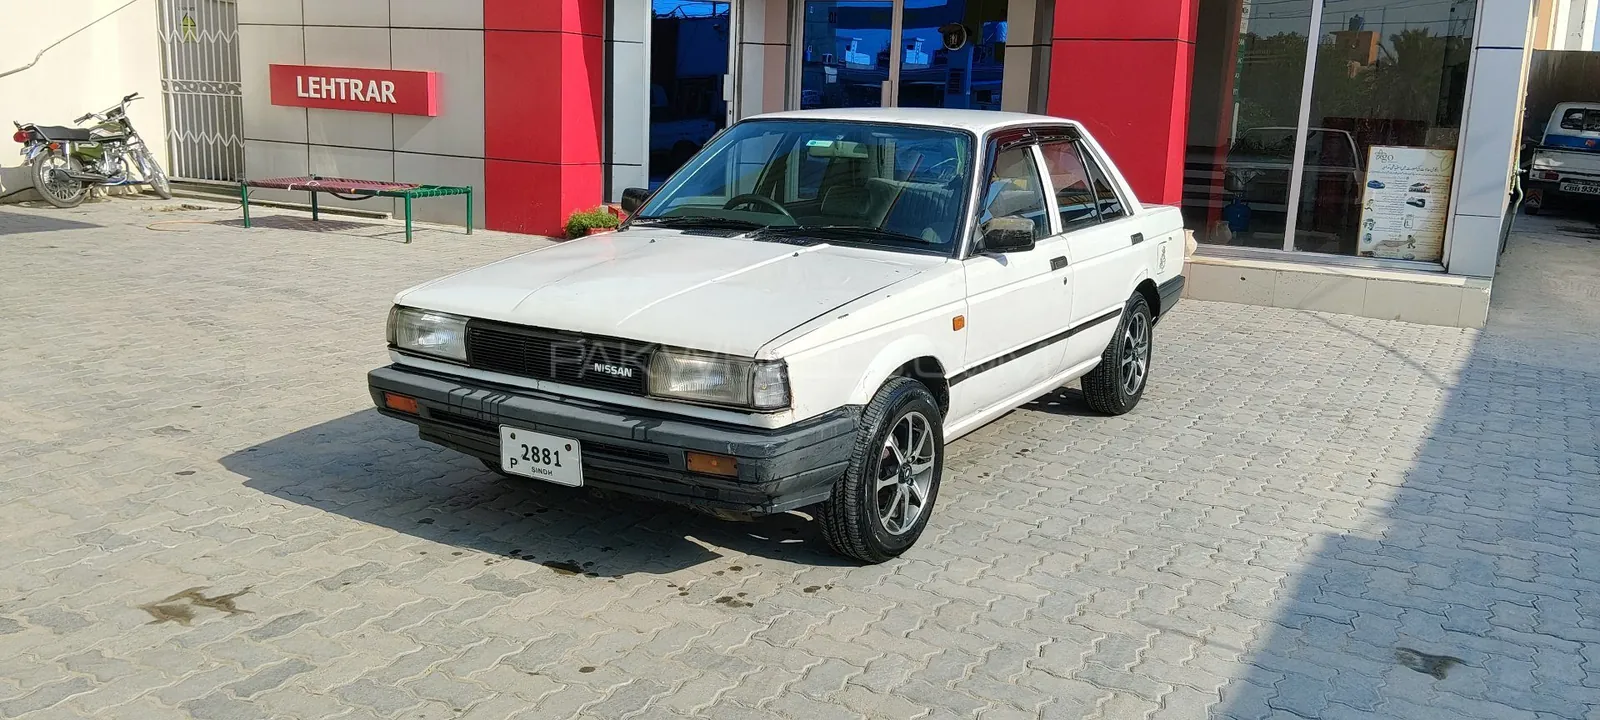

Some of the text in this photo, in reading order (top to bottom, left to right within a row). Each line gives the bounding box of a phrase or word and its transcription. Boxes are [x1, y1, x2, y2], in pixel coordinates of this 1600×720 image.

[296, 75, 397, 104] LEHTRAR
[1581, 185, 1600, 194] 938
[594, 362, 633, 378] NISSAN
[521, 443, 562, 468] 2881
[509, 457, 518, 469] P
[531, 466, 554, 476] SINDH
